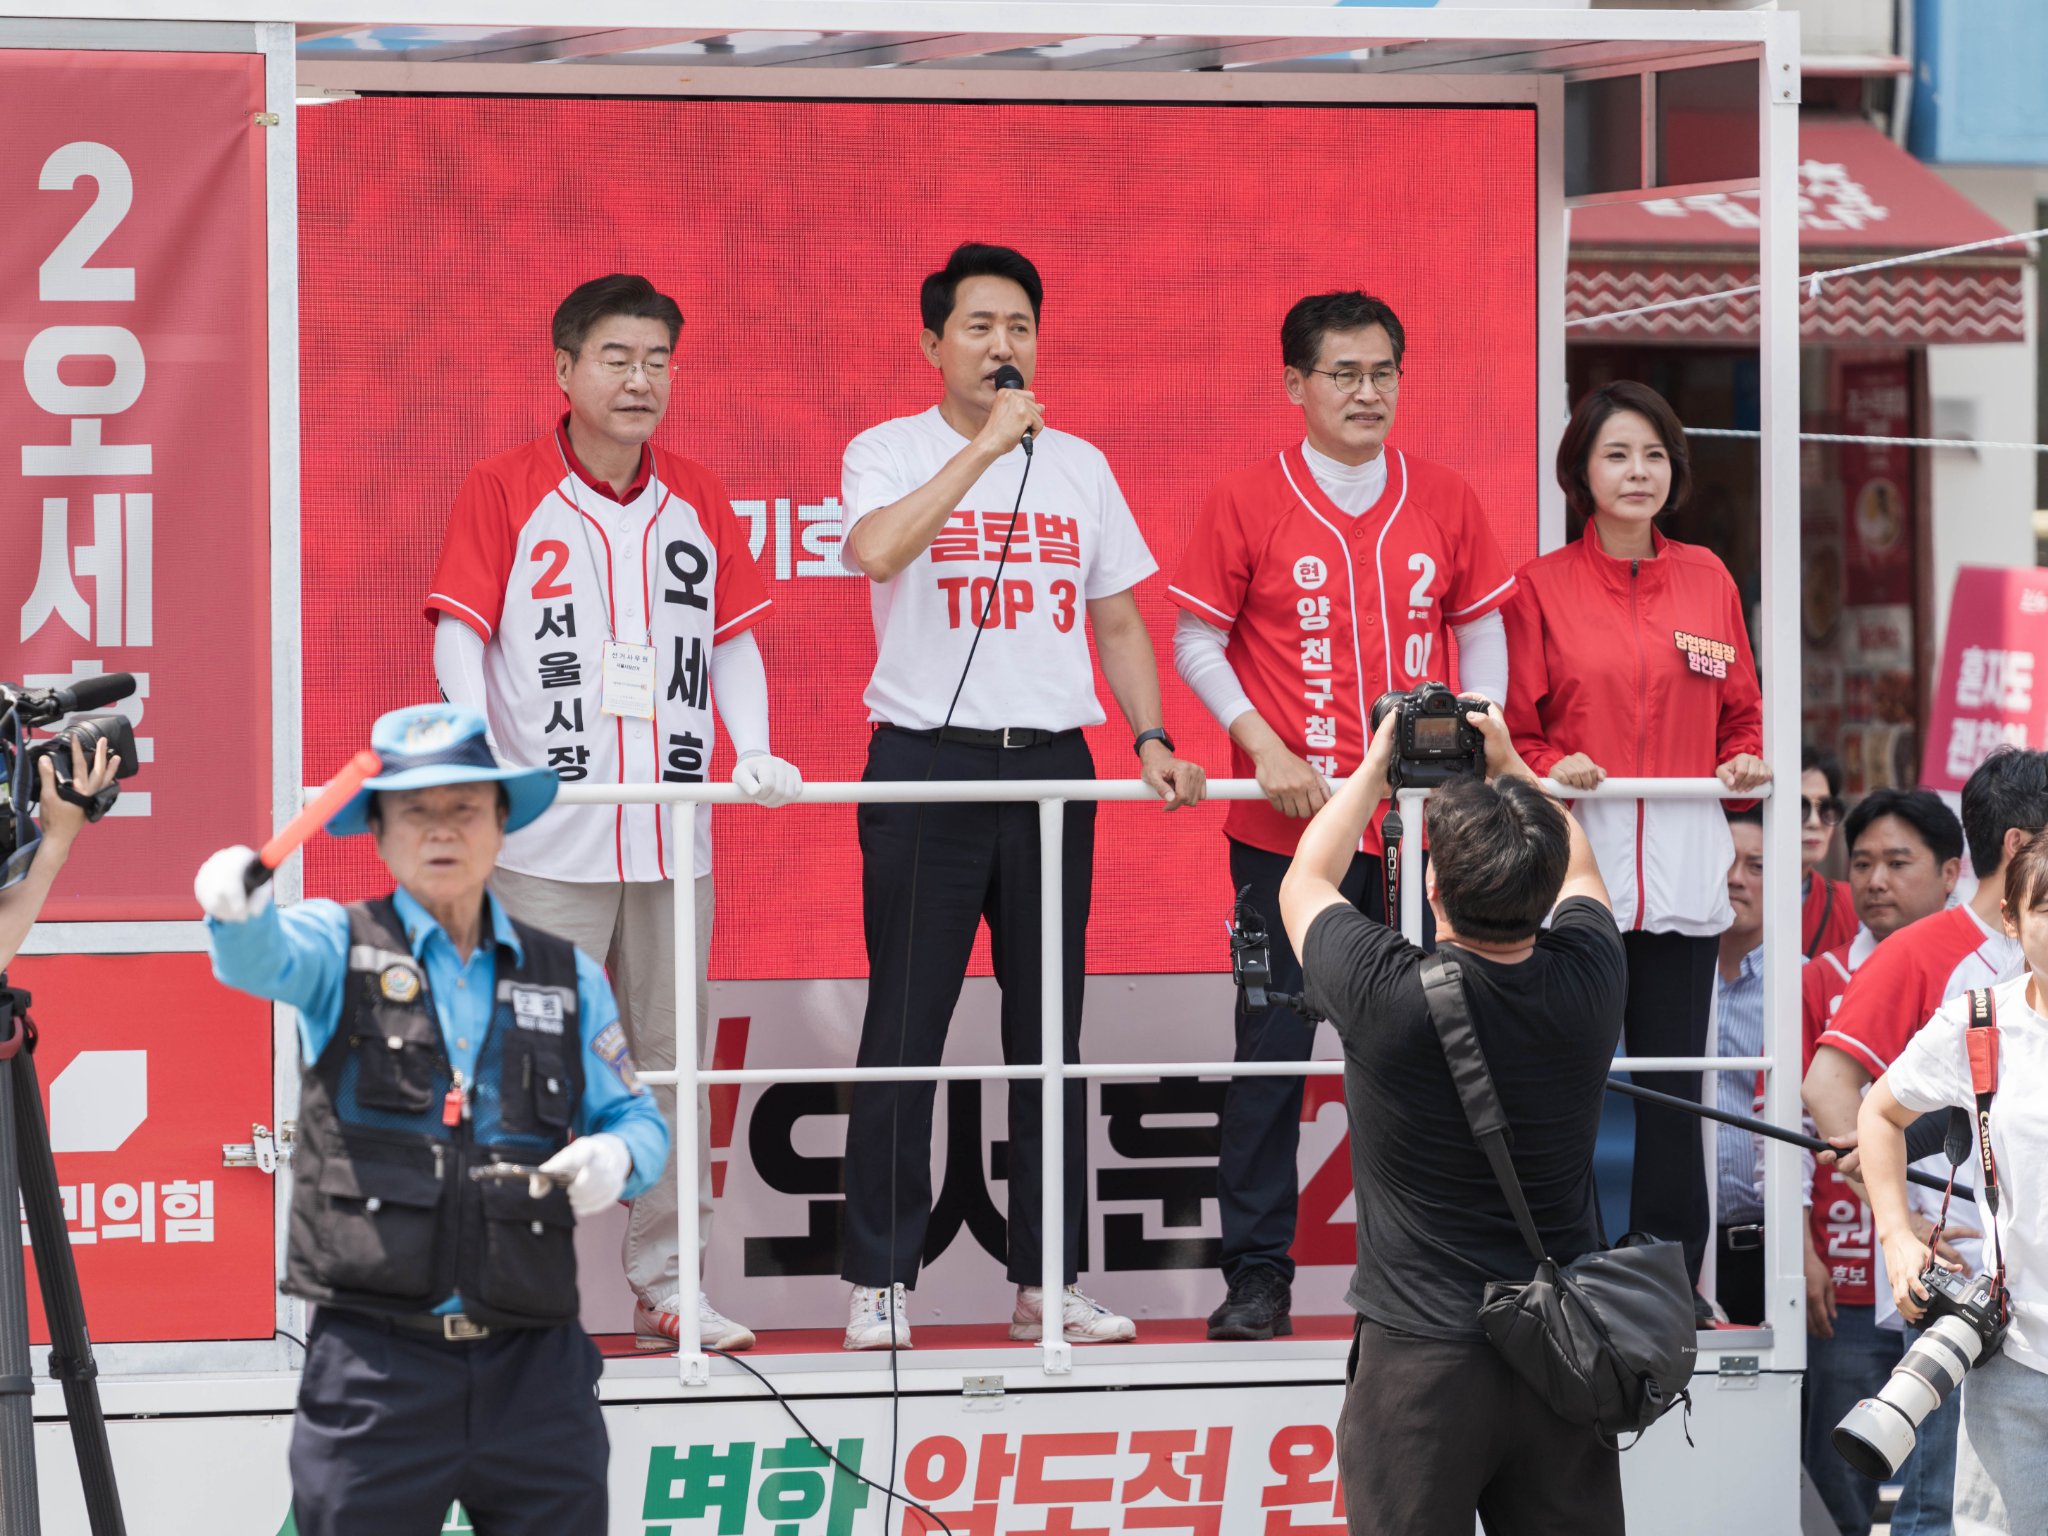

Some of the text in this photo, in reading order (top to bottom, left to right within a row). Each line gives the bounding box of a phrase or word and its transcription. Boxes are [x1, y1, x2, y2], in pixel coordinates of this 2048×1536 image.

[38, 141, 136, 302] 2
[930, 510, 1081, 568] 글로벌
[530, 539, 573, 600] 2
[1407, 553, 1436, 608] 2
[937, 576, 1077, 634] TOP 3
[1674, 631, 1736, 663] 당협위원장
[534, 602, 590, 782] 서울시장
[1387, 846, 1398, 881] EOS
[1388, 885, 1396, 903] 5D
[1979, 1110, 1991, 1171] Canon
[19, 1179, 215, 1246] 민의힘
[1831, 1265, 1868, 1287] 후보
